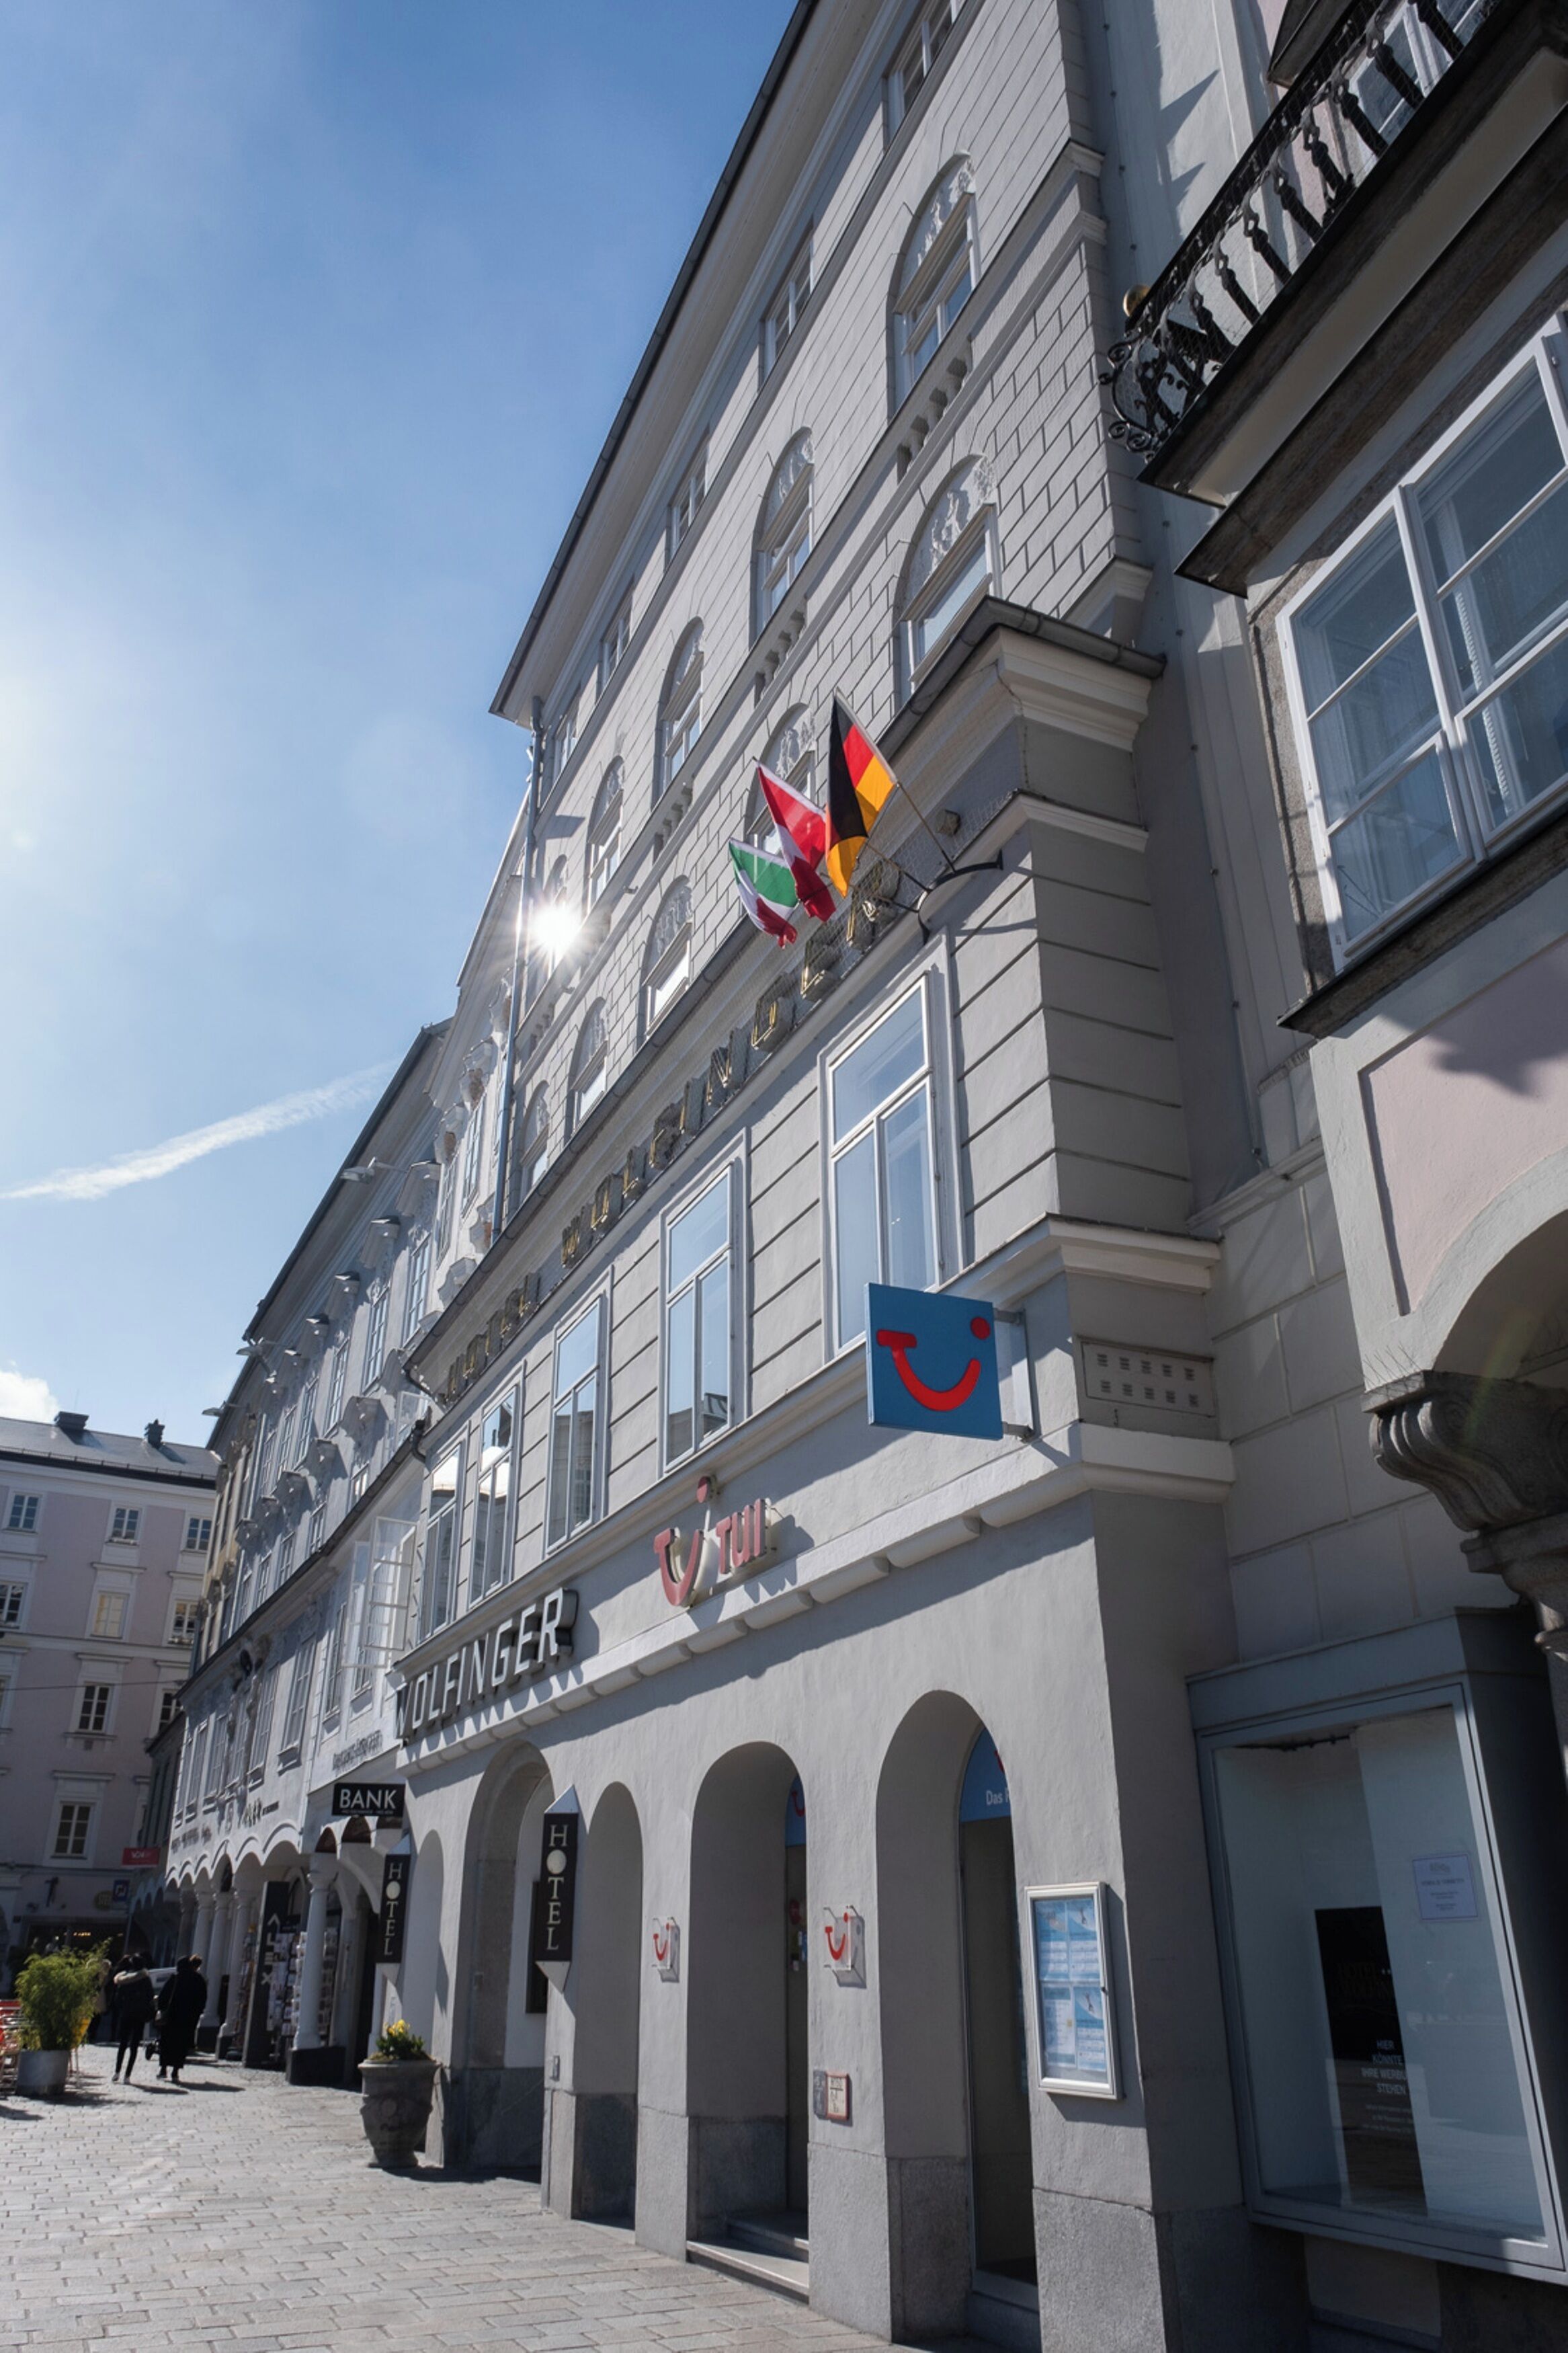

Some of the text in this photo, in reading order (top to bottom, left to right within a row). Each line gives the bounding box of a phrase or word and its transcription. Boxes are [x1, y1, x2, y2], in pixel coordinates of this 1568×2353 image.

[395, 1587, 566, 1740] WOLFINGER
[339, 1789, 397, 1809] BANK
[986, 1790, 1003, 1806] Das
[546, 1824, 569, 1950] HOTEL
[384, 1862, 403, 1956] HOTEL
[1376, 2039, 1395, 2050] HIER
[1376, 2083, 1407, 2096] STEHEN
